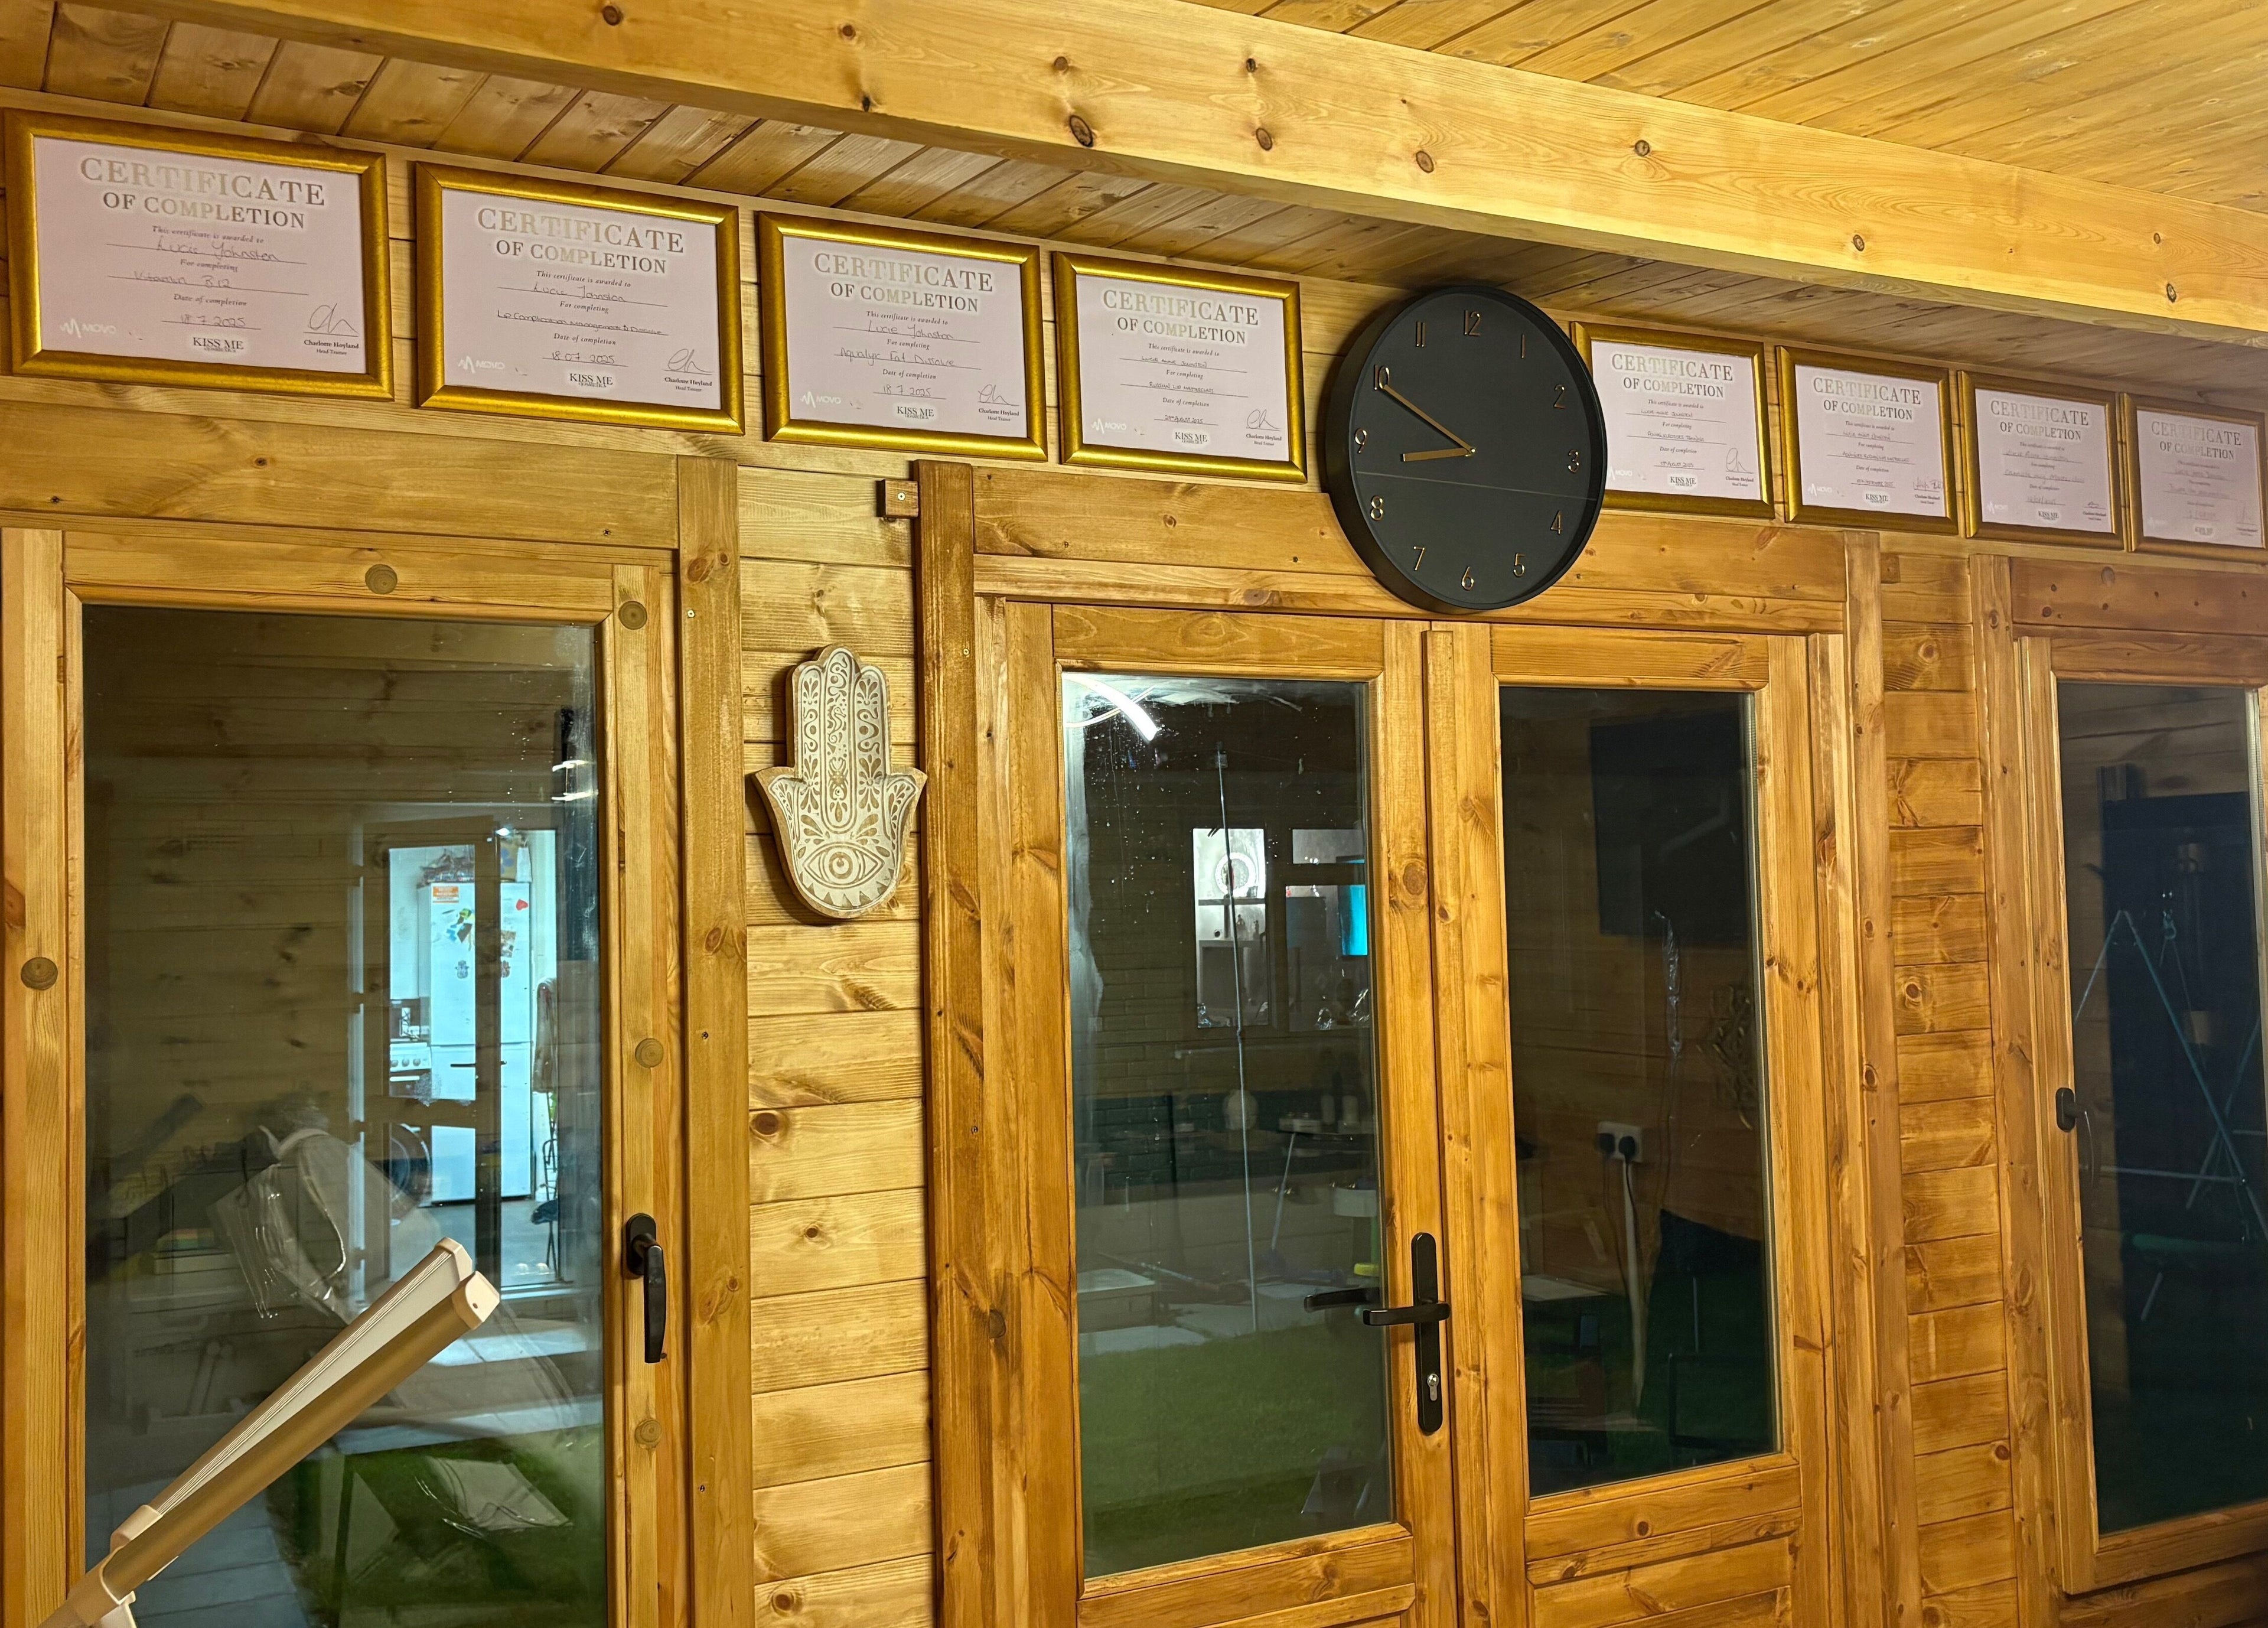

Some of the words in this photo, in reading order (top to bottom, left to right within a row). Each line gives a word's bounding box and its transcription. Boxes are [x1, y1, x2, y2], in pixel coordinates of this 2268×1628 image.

[80, 157, 325, 206] CERTIFICATE
[103, 192, 135, 210] OF
[145, 197, 305, 229] COMPLETION
[477, 207, 684, 253] CERTIFICATE
[197, 262, 238, 272] completing
[496, 240, 523, 256] OF
[530, 243, 667, 274] COMPLETION
[536, 270, 551, 278] This
[553, 273, 585, 282] certificate
[595, 278, 623, 287] awarded
[814, 253, 993, 292] CERTIFICATE
[174, 294, 193, 302] Date
[206, 298, 247, 307] completion
[573, 303, 609, 314] completing
[830, 282, 855, 297] OF
[860, 286, 978, 312] COMPLETION
[1103, 289, 1259, 325] CERTIFICATE
[881, 313, 908, 322] certificate
[917, 317, 940, 325] awarded
[1117, 317, 1138, 331] OF
[1143, 320, 1246, 344] COMPLETION
[1464, 310, 1482, 336] 12
[193, 337, 220, 347] KISS
[224, 340, 244, 350] ME
[553, 333, 569, 341] Date
[581, 336, 616, 346] completion
[899, 341, 930, 350] completing
[1415, 321, 1426, 347] 11
[1520, 334, 1526, 359] 1
[590, 354, 615, 364] 2025
[1611, 353, 1733, 381] CERTIFICATE
[569, 373, 593, 383] KISS
[596, 376, 613, 385] ME
[906, 370, 936, 380] completion
[1177, 372, 1204, 380] completing
[1373, 364, 1390, 390] 10
[910, 387, 931, 396] 2025
[1553, 385, 1566, 409] 2
[1624, 377, 1640, 389] OF
[1644, 379, 1723, 398] COMPLETION
[1813, 377, 1921, 405] CERTIFICATE
[816, 395, 841, 404] MOVO
[1182, 399, 1210, 407] completion
[1824, 399, 1837, 411] OF
[1842, 402, 1912, 420] COMPLETION
[897, 406, 917, 415] KISS
[920, 408, 934, 417] ME
[1990, 400, 2088, 425] CERTIFICATE
[1104, 422, 1127, 430] MOVO
[1175, 432, 1193, 440] KISS
[1194, 434, 1207, 442] ME
[2000, 422, 2012, 432] OF
[2016, 423, 2081, 441] COMPLETION
[2151, 421, 2241, 445] CERTIFICATE
[1354, 428, 1368, 454] 9
[2160, 441, 2172, 452] OF
[1567, 450, 1580, 473] 3
[1370, 495, 1384, 521] 8
[1550, 510, 1562, 534] 4
[1413, 545, 1425, 571] 7
[1512, 552, 1526, 577] 5
[1461, 566, 1475, 591] 6
